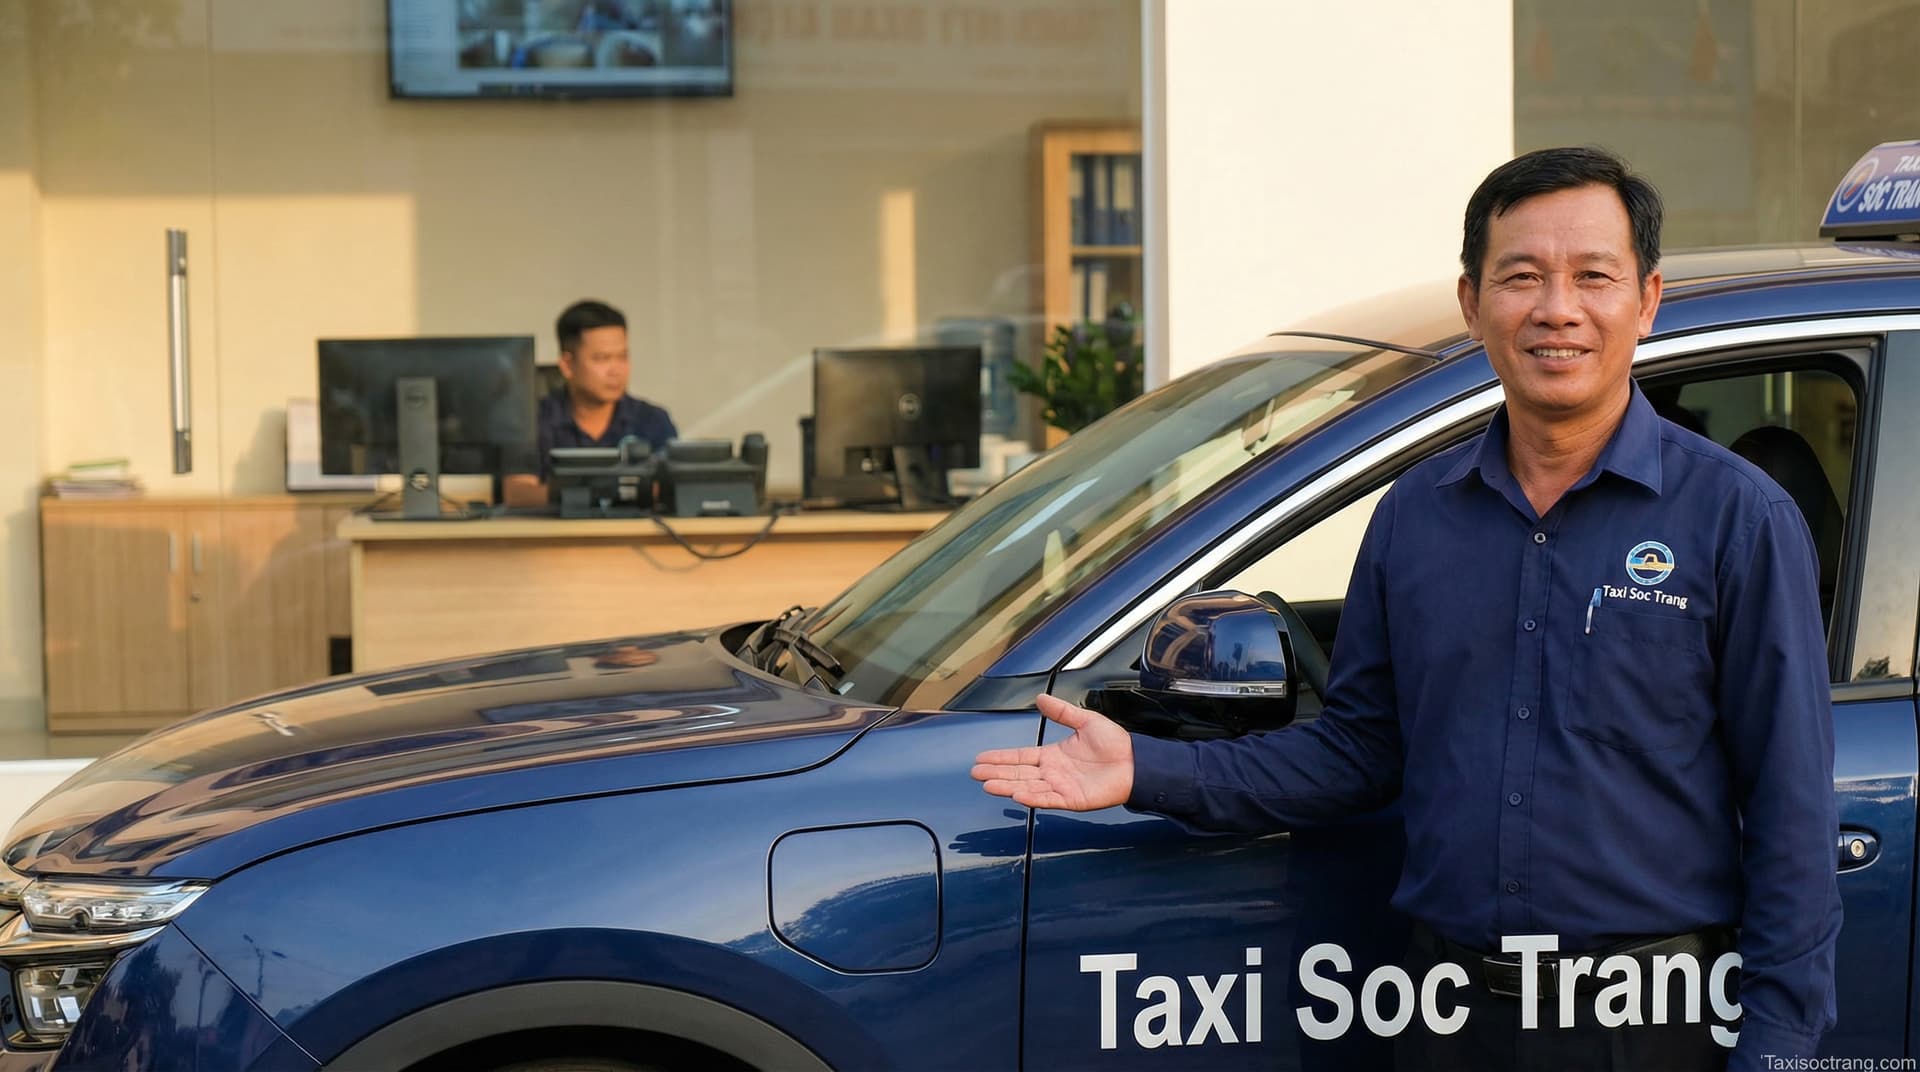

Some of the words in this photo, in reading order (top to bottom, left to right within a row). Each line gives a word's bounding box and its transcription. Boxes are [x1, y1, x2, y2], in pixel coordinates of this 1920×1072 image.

[1603, 585, 1627, 598] Taxi
[1629, 587, 1651, 601] Soc
[1653, 590, 1688, 610] Trang
[1079, 947, 1262, 1050] Taxi
[1296, 942, 1471, 1041] Soc
[1501, 934, 1744, 1048] Trang
